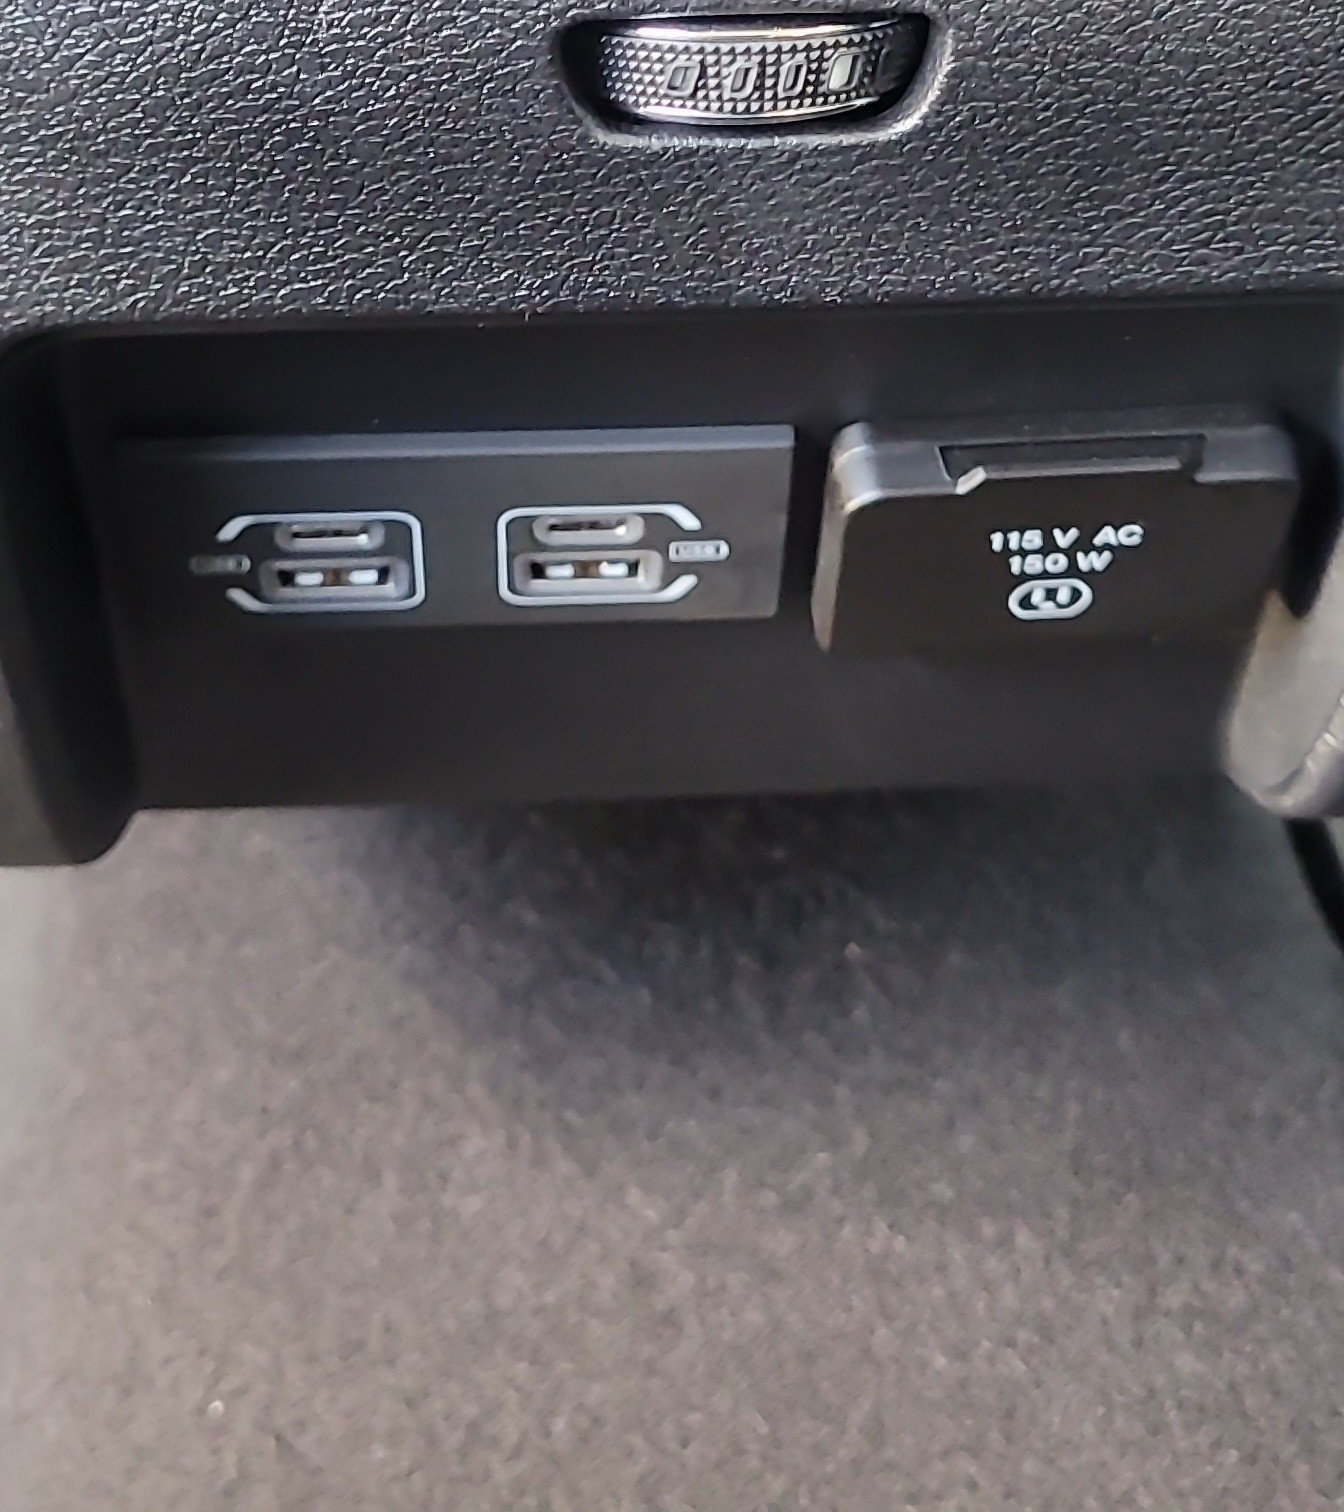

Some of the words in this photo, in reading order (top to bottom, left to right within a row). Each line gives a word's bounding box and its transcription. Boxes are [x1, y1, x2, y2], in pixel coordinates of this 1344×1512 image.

[990, 529, 1043, 552] 115
[1052, 526, 1081, 549] V
[1092, 524, 1144, 547] AC
[1009, 552, 1069, 575] 150
[1076, 550, 1113, 573] W
